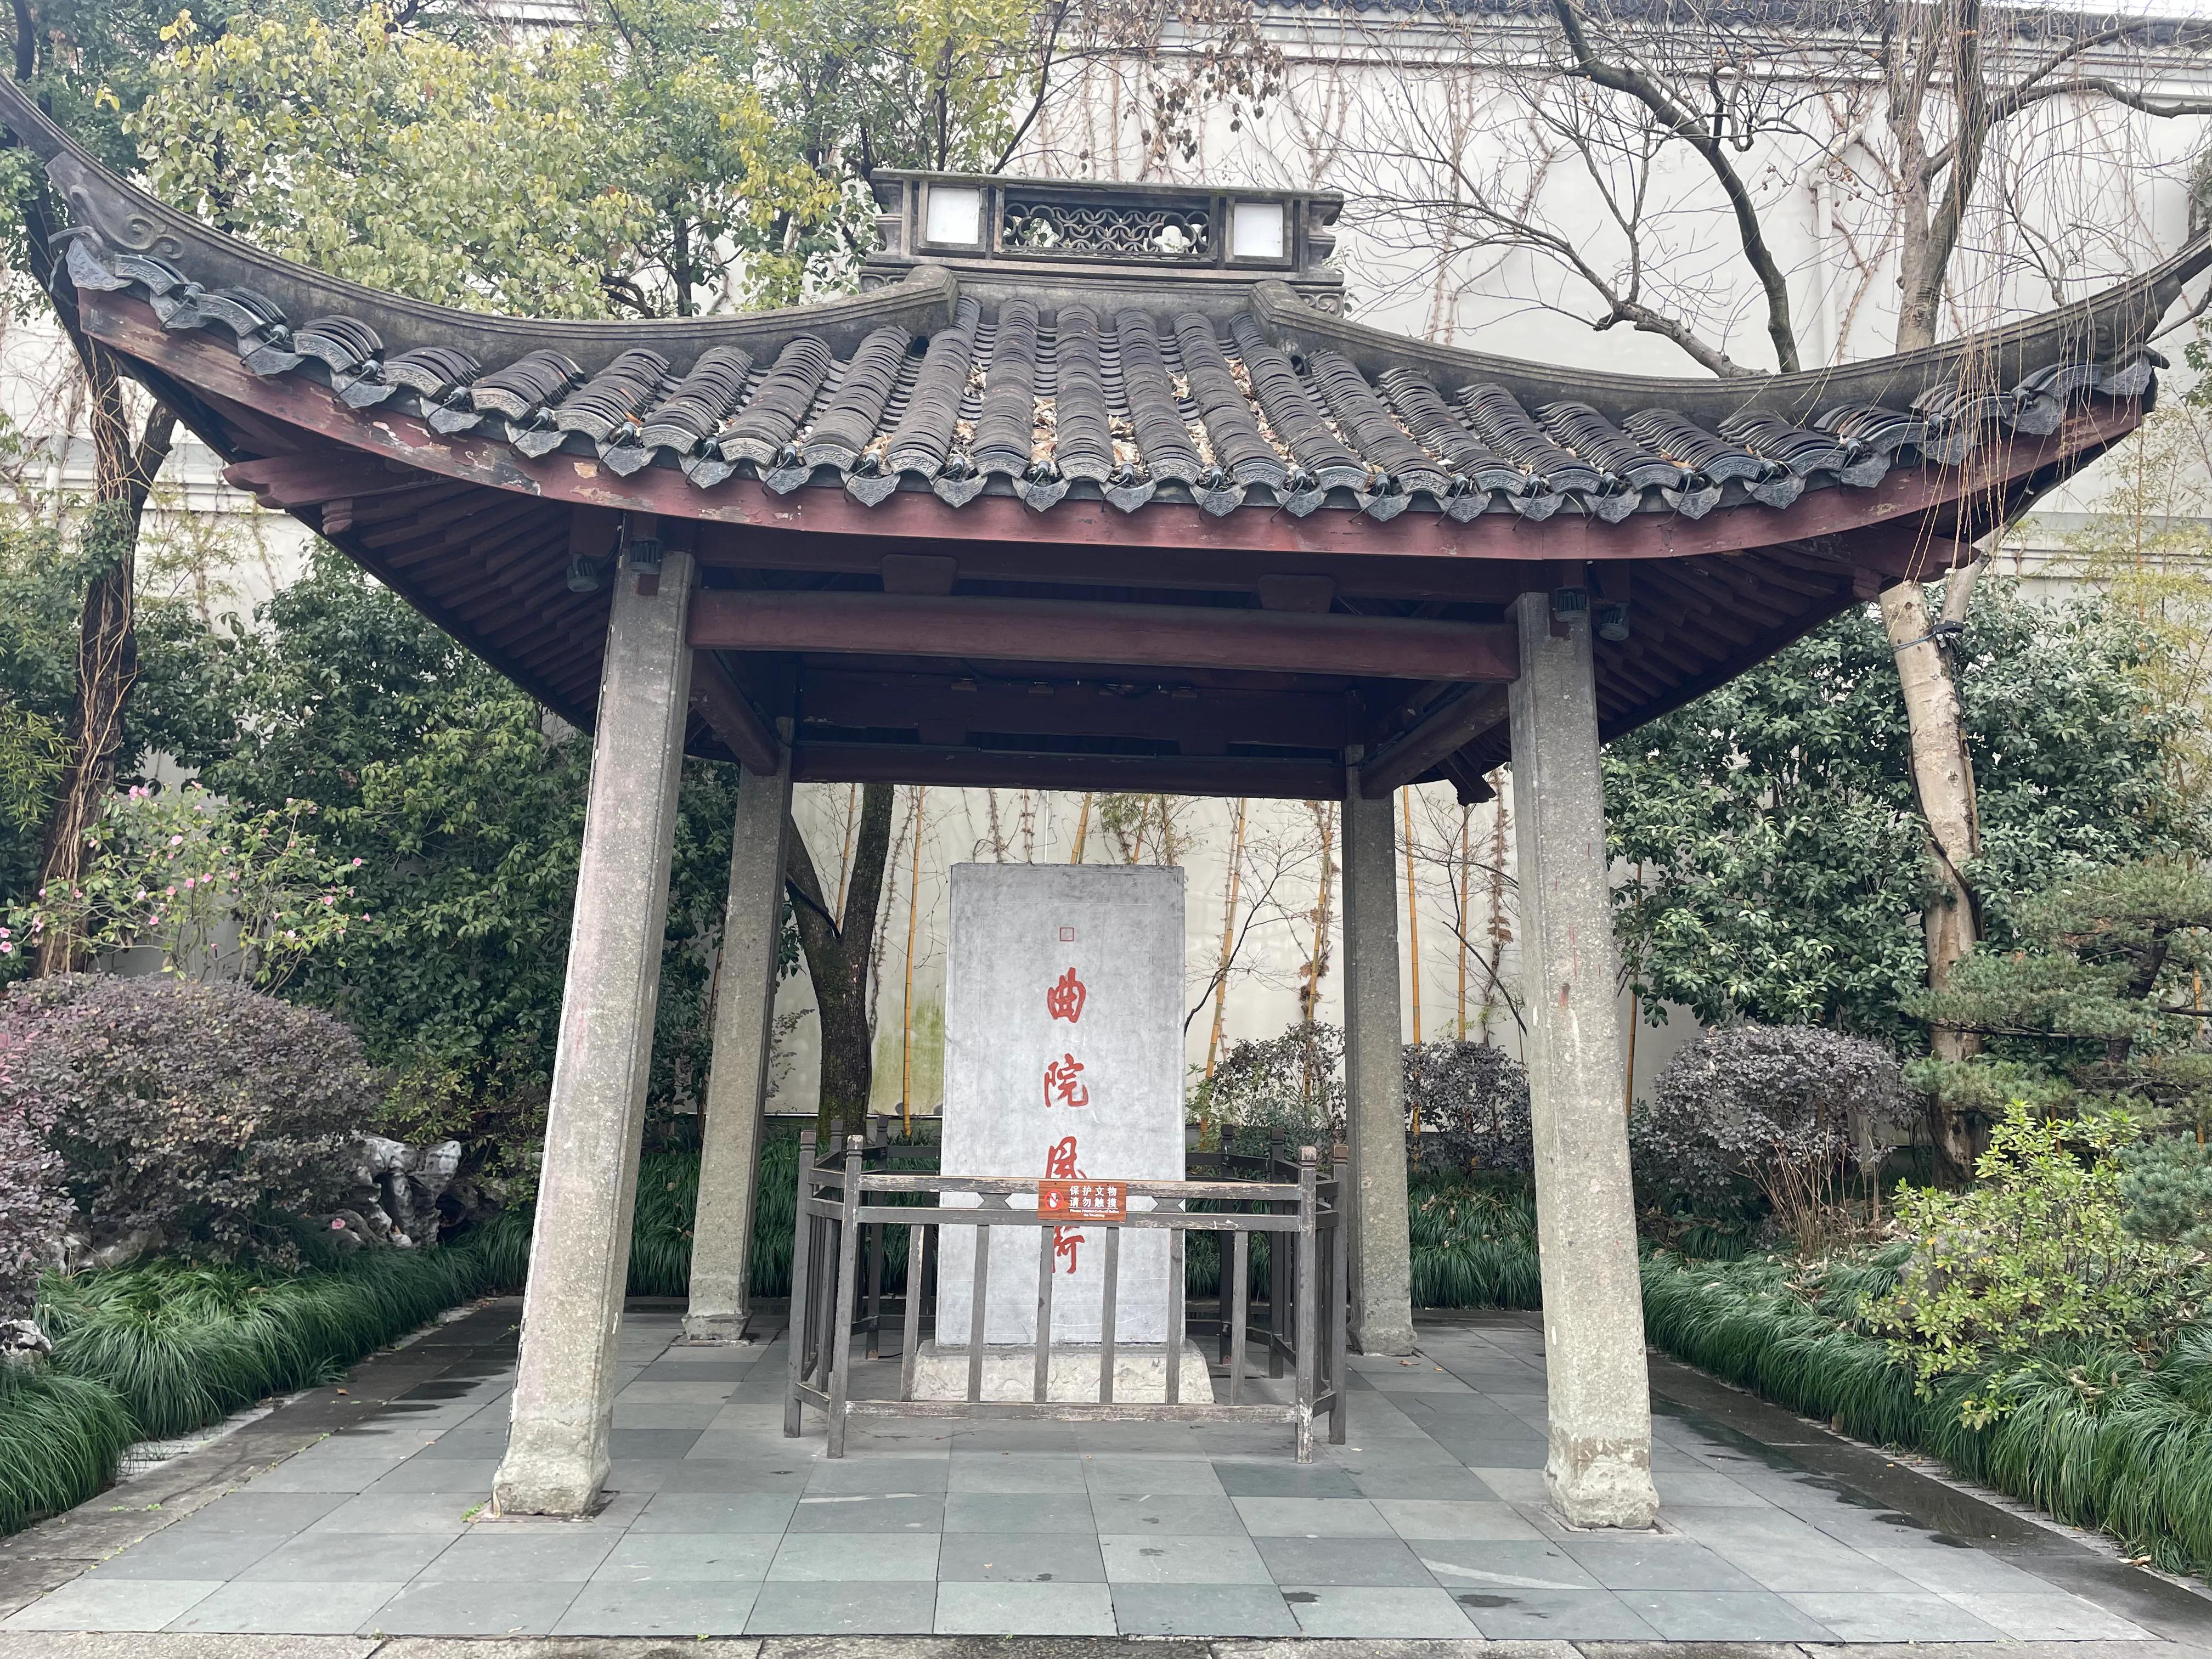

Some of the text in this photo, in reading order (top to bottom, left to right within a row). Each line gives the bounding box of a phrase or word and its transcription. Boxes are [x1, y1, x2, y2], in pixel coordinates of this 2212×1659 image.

[1070, 1186, 1117, 1197] 保护文物
[1070, 1197, 1117, 1208] 请勿触摸
